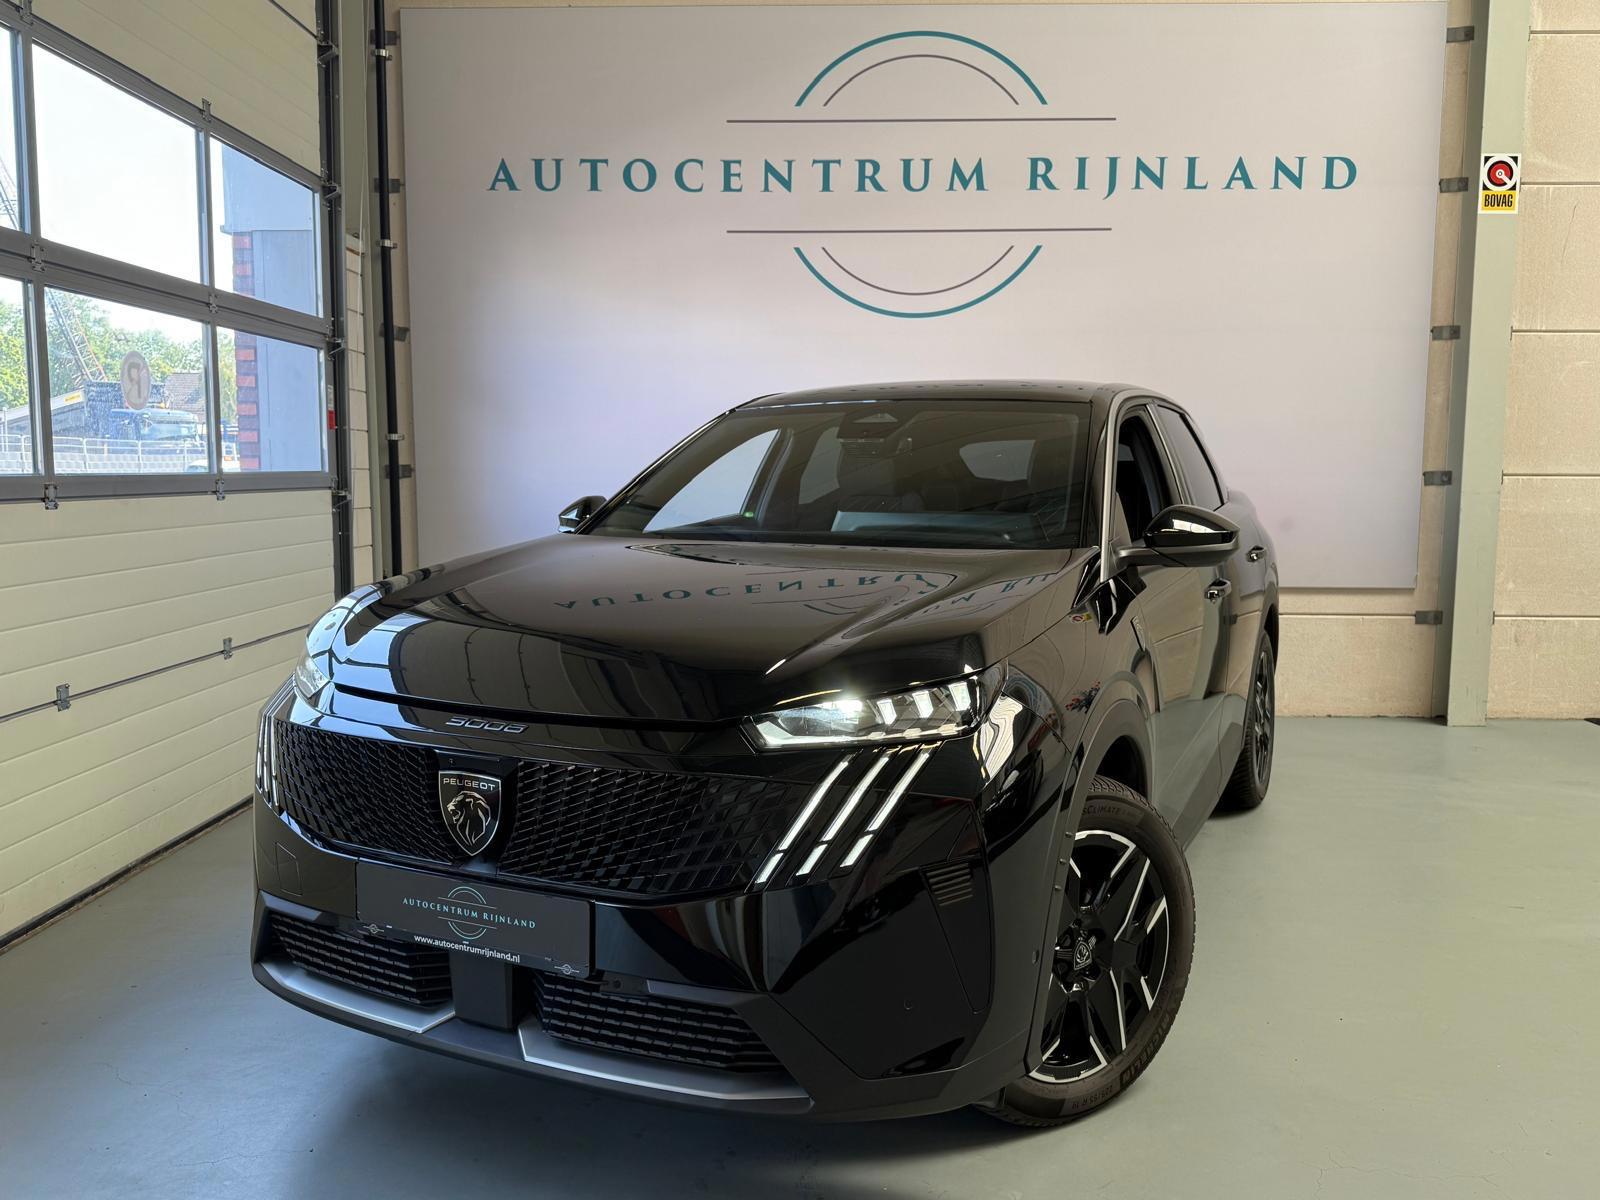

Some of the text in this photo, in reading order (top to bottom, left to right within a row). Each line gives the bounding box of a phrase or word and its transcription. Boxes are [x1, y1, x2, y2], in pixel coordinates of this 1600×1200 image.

[487, 156, 1358, 200] AUTOCENTRUM RIJNLAND
[1484, 193, 1514, 208] BOVAG
[445, 715, 529, 734] 3008
[443, 778, 496, 792] PEUGEOT
[402, 896, 536, 930] AUTOCENTRUM RIJNLAND
[413, 935, 521, 963] www.autocentrumrijnland.nl
